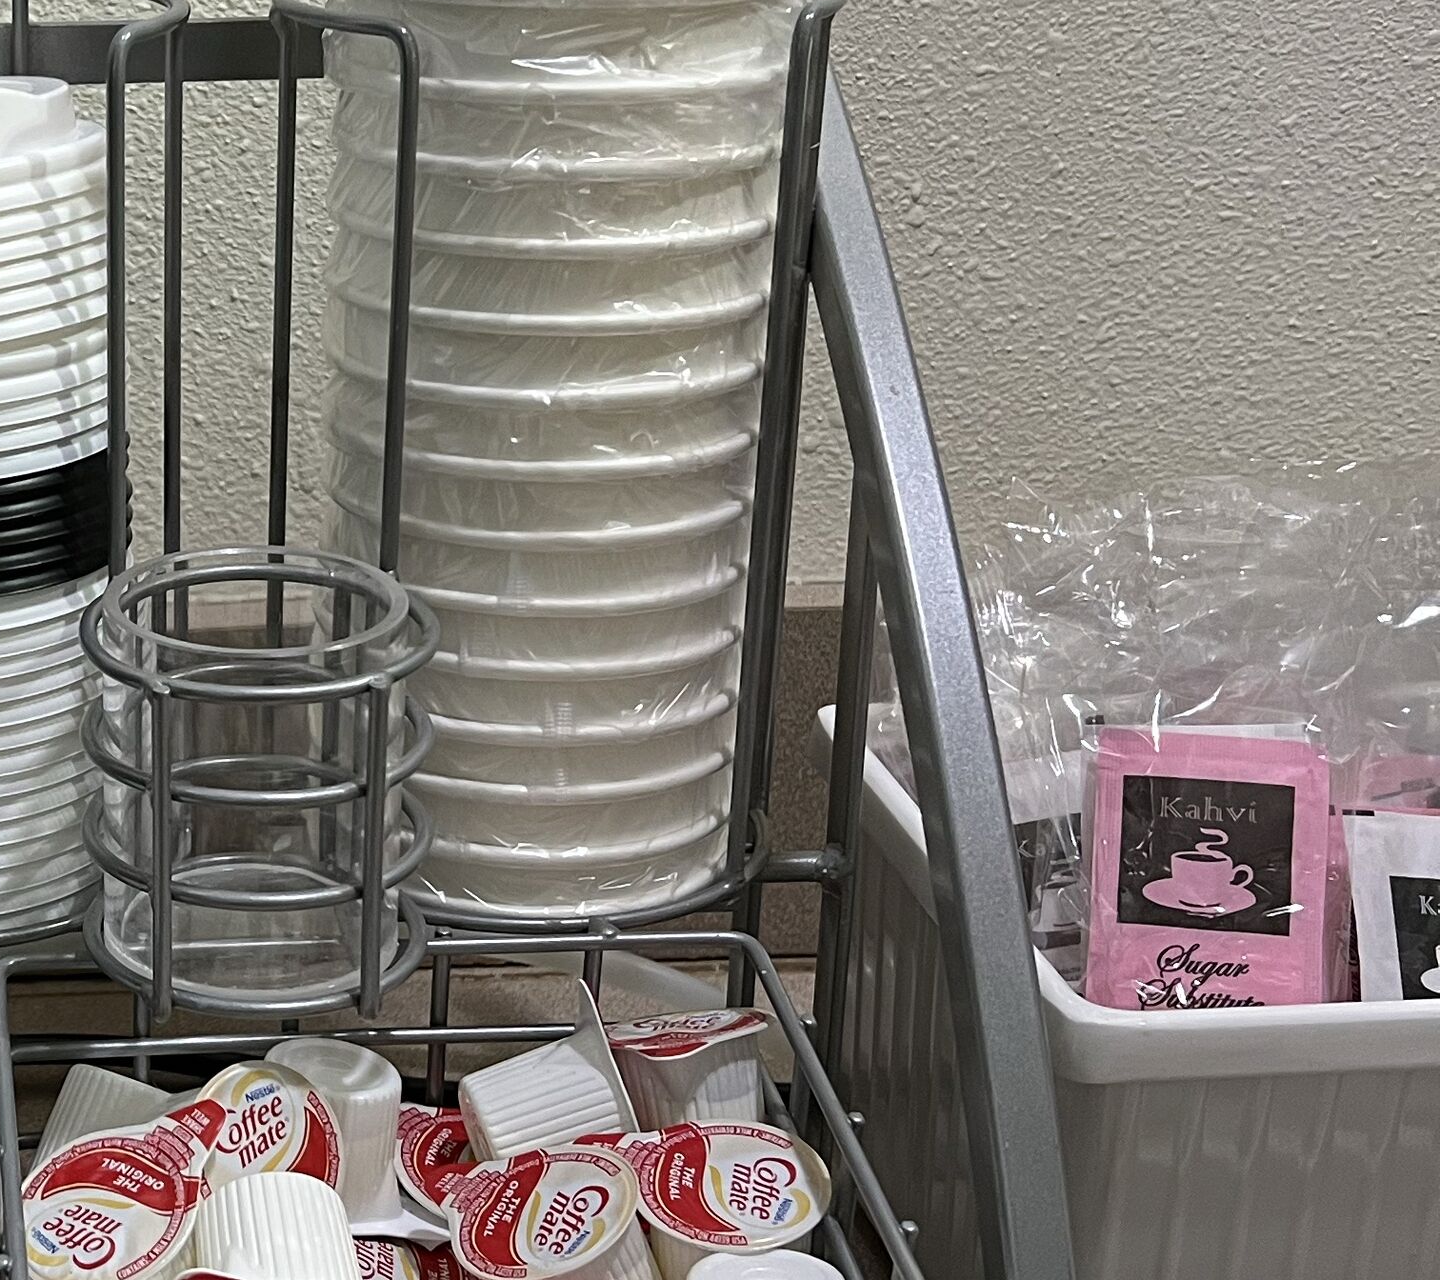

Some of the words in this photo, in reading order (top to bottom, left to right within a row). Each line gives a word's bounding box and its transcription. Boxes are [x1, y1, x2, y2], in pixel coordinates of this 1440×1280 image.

[1159, 795, 1259, 826] Kahvi
[1157, 943, 1250, 987] Sugar
[239, 1120, 286, 1168] mate
[424, 1127, 453, 1166] ORIGINAL
[101, 1157, 165, 1191] ORIGINAL
[113, 1175, 140, 1193] THE
[668, 1152, 682, 1201] ORIGINAL
[681, 1167, 696, 1189] THE
[729, 1162, 752, 1212] mate
[751, 1157, 797, 1220] Coffee
[64, 1204, 123, 1235] mate
[483, 1180, 520, 1237] ORIGINAL
[502, 1196, 521, 1222] THE
[534, 1191, 571, 1246] mate
[548, 1185, 610, 1255] Coffee
[43, 1217, 116, 1270] Coffee
[377, 1242, 394, 1280] mate
